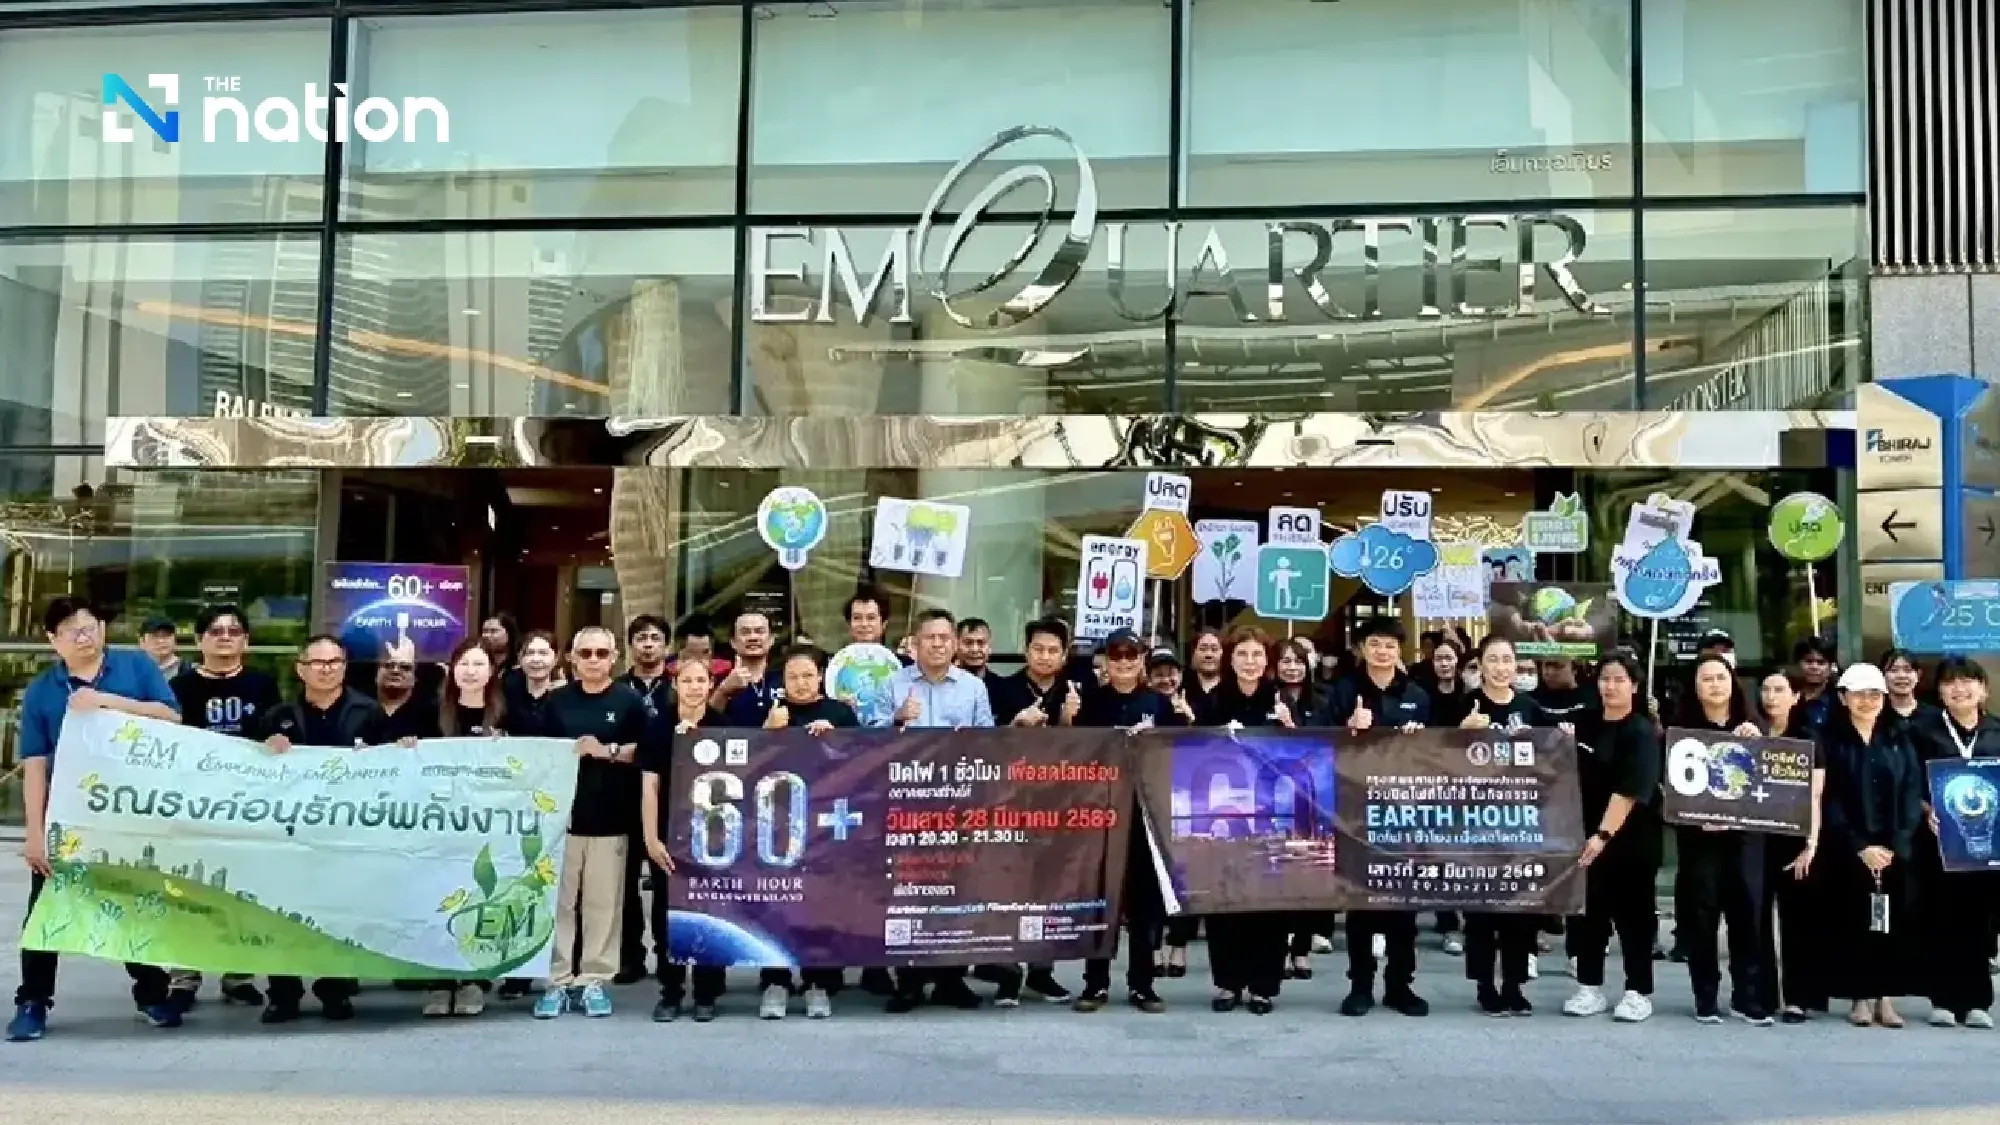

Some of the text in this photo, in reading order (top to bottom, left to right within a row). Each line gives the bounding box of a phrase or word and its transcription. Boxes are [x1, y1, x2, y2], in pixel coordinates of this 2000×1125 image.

[750, 124, 1613, 365] EMQUARTIER
[1384, 493, 1428, 517] ปรับ
[1278, 513, 1312, 532] ลด
[1091, 541, 1140, 560] energy
[388, 574, 434, 600] 60+
[1084, 612, 1135, 627] saving
[1941, 604, 1974, 627] 25
[206, 696, 255, 724] 60+
[128, 736, 179, 762] EM
[888, 756, 1120, 783] ปิดไฟ 1 ชั่วโมง เพื่อลดโลกร้อน
[87, 783, 540, 836] รณรงค์อนุรักษ์พลังงาน
[887, 804, 1119, 831] วันเสาร์ 28 มีนาคม 2569
[1367, 804, 1540, 827] EARTH HOUR
[918, 830, 959, 846] 20.30
[973, 830, 1012, 844] 21.30
[1444, 862, 1498, 879] มีนาคม
[688, 876, 804, 890] EARTH HOUR
